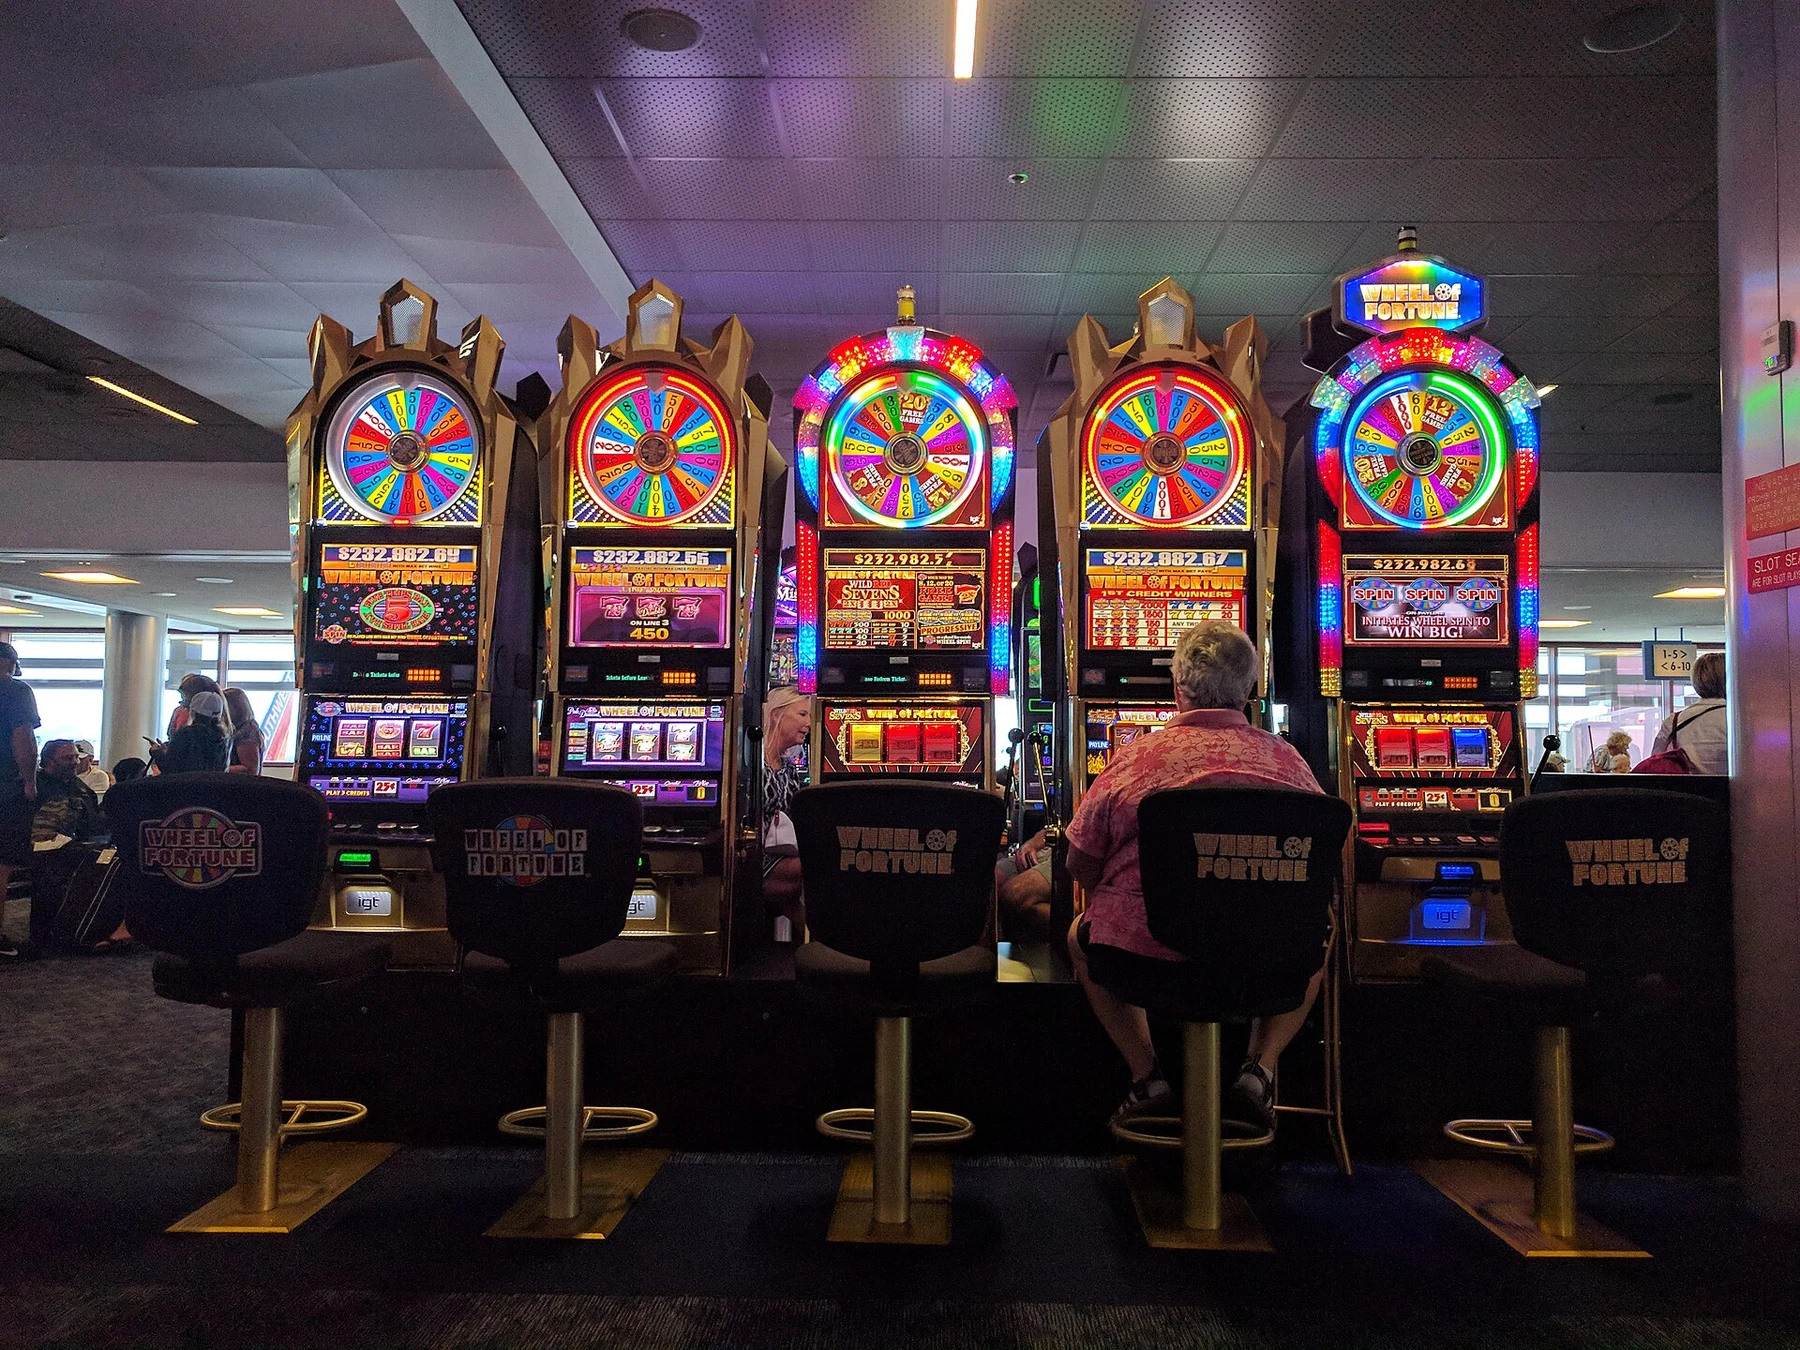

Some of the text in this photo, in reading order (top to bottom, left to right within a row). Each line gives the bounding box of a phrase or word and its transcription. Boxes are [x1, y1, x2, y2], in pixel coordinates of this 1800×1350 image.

[1360, 284, 1434, 302] WHEEL
[1365, 302, 1459, 321] FORTUNE
[409, 392, 416, 415] 50
[904, 396, 926, 410] 20
[1413, 394, 1420, 415] 60
[1428, 399, 1452, 415] 12
[394, 395, 407, 428] 100
[622, 401, 638, 422] 80
[663, 396, 678, 429] 500
[1128, 401, 1144, 423] 75
[1169, 396, 1183, 430] 500
[1396, 396, 1411, 430] 1000
[1424, 411, 1447, 423] FREE
[365, 411, 393, 438] 1000
[611, 413, 638, 438] 150
[900, 416, 923, 425] GAMES
[936, 414, 953, 431] 80
[1115, 413, 1144, 439] 100
[1421, 417, 1446, 430] GAMES
[692, 427, 715, 440] 75
[1360, 428, 1381, 441] 80
[1443, 428, 1475, 446] 250
[351, 442, 385, 450] 150
[436, 443, 471, 453] 100
[595, 442, 631, 453] 2000
[683, 444, 718, 453] 100
[845, 443, 877, 453] 500
[1101, 443, 1136, 454] 400
[1190, 443, 1225, 454] 250
[349, 454, 373, 463] 30
[448, 456, 470, 466] 75
[933, 456, 969, 466] 1000
[1100, 457, 1124, 466] 20
[1202, 457, 1225, 467] 75
[600, 463, 633, 482] 250
[1128, 477, 1150, 507] 100
[1754, 556, 1780, 573] SLOT
[324, 570, 379, 584] WHEEL
[402, 571, 474, 585] FORTUNE
[575, 573, 632, 587] WHEEL
[654, 574, 727, 587] FORTUNE
[1090, 576, 1147, 589] WHEEL
[1170, 576, 1244, 590] FORTUNE
[1752, 570, 1800, 588] ARE FOR SLOT PLAY
[842, 586, 900, 600] SEVENS
[920, 587, 952, 595] FREE
[1355, 589, 1394, 599] SPIN
[1406, 589, 1445, 600] SPIN
[1457, 589, 1498, 600] SPIN
[919, 595, 954, 603] GAMES
[883, 612, 911, 620] 1000
[1362, 617, 1491, 626] INITIATES WHEEL SPIN TO
[630, 628, 669, 640] 450
[921, 624, 977, 635] PROGRESSIVE
[1388, 627, 1463, 638] WIN BIG!
[1663, 650, 1678, 659] 1-5
[1671, 662, 1691, 671] 6-10
[345, 703, 383, 713] WHEEL
[399, 704, 449, 714] FORTUNE
[601, 706, 640, 717] WHEEL
[656, 707, 705, 716] FORTUNE
[867, 710, 898, 719] WHEEL
[913, 710, 959, 719] FORTUNE
[830, 712, 862, 720] SEVENS
[1119, 711, 1159, 721] WHEEL
[1356, 716, 1388, 725] SEVENS
[1394, 714, 1425, 723] WHEEL
[1442, 714, 1488, 723] FORTUNE
[413, 747, 437, 755] BAR
[145, 828, 256, 847] WHEEL OF
[465, 829, 587, 851] WHEEL OF
[836, 826, 924, 851] WHEEL
[1193, 833, 1282, 858] WHEEL
[1565, 838, 1660, 863] WHEEL
[145, 848, 255, 866] FORTUNE
[840, 850, 953, 875] FORTUNE
[467, 854, 584, 876] FORTUNE
[1197, 857, 1308, 882] FORTUNE
[1573, 861, 1686, 886] FORTUNE
[358, 897, 380, 910] igt
[628, 901, 645, 914] gt
[1437, 910, 1459, 923] igt
